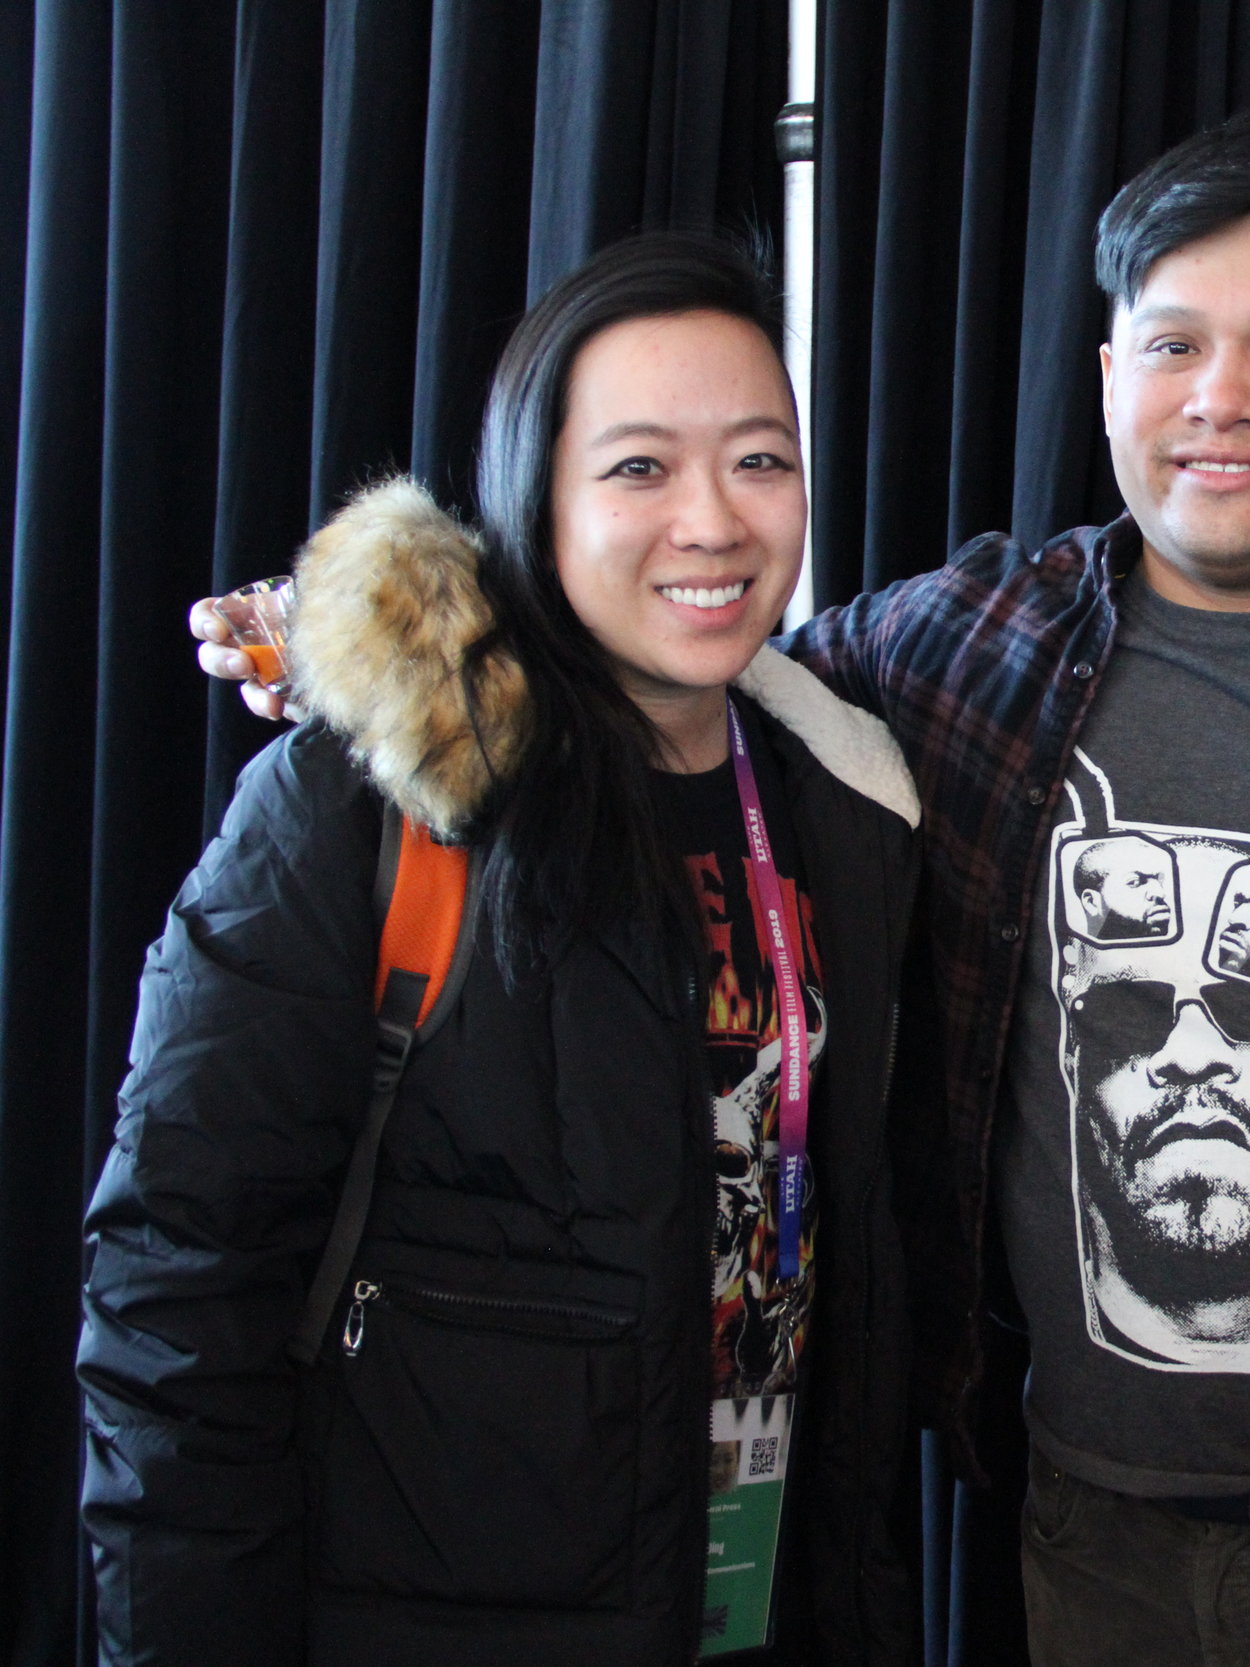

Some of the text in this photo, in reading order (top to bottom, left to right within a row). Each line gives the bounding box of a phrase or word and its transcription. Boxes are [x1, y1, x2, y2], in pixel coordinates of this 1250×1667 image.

[748, 807, 768, 862] UTAH
[768, 909, 800, 1101] SUNDANCE FILM FESTIVAL 2019
[785, 1155, 797, 1213] UTAH
